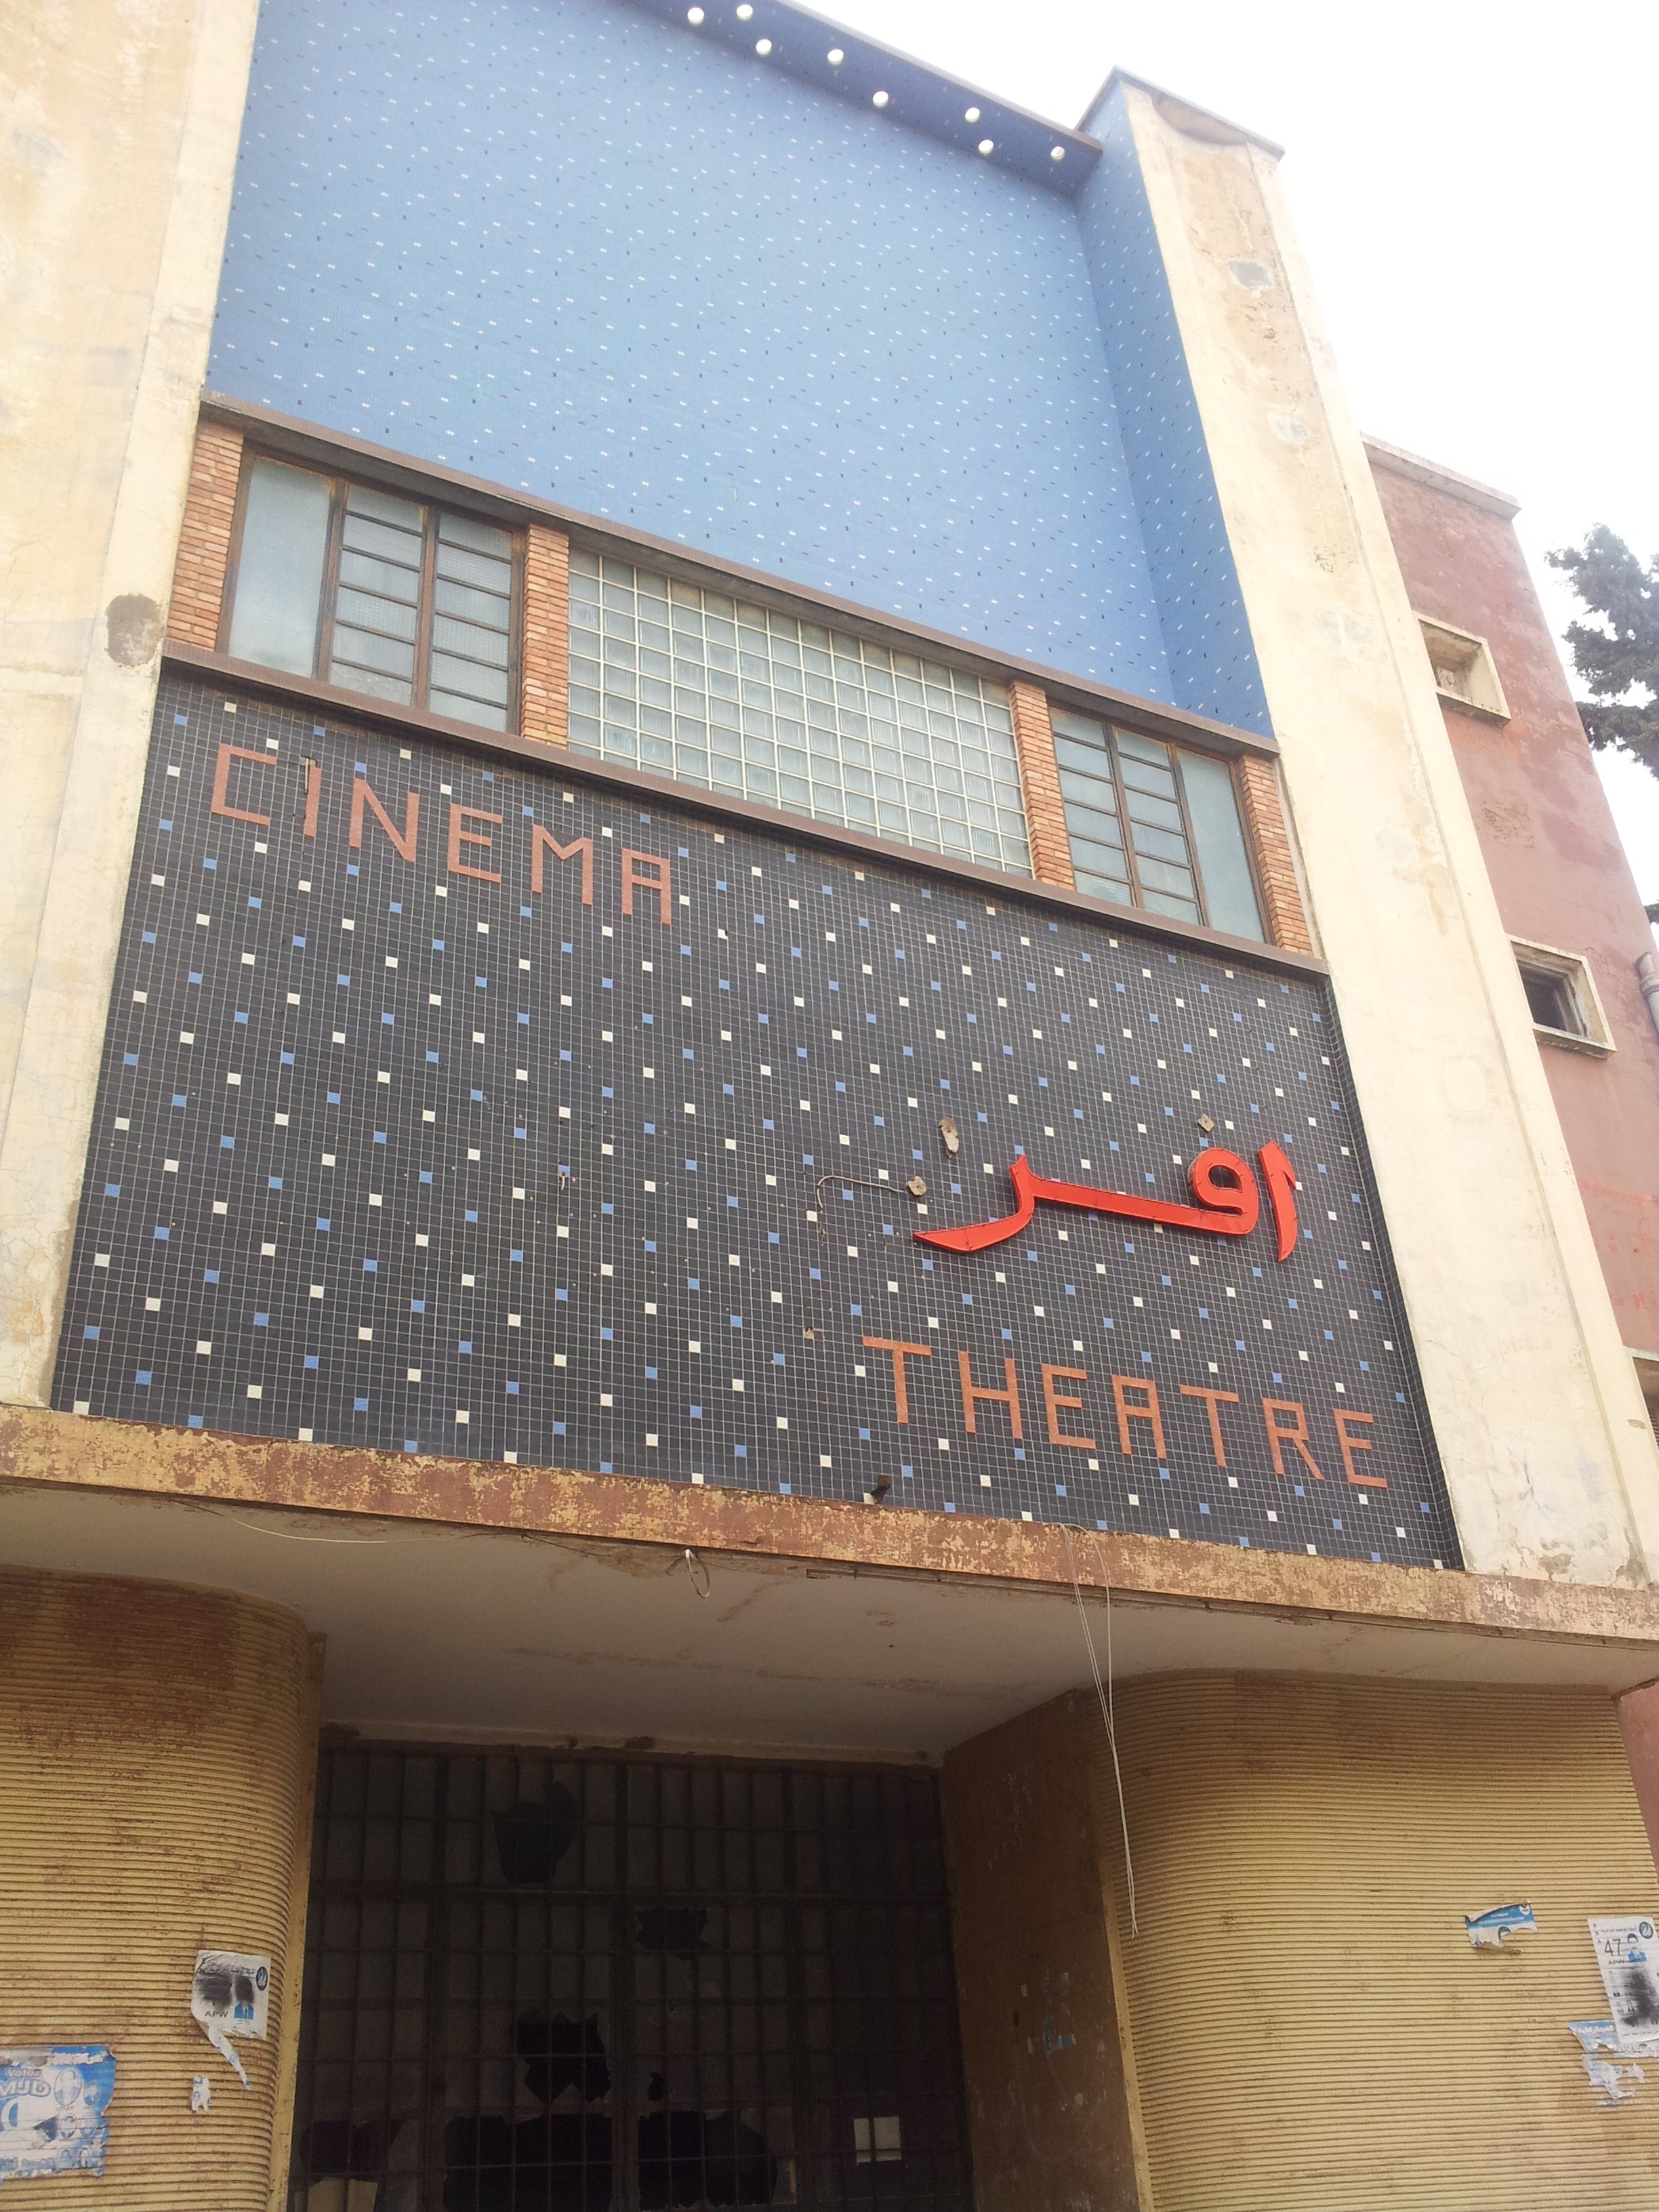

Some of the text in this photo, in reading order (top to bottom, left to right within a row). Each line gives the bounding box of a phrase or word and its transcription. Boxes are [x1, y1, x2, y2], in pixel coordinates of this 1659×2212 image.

[211, 743, 672, 924] CINEMA
[862, 1336, 1387, 1488] THEATRE
[1605, 1939, 1621, 1956] 47
